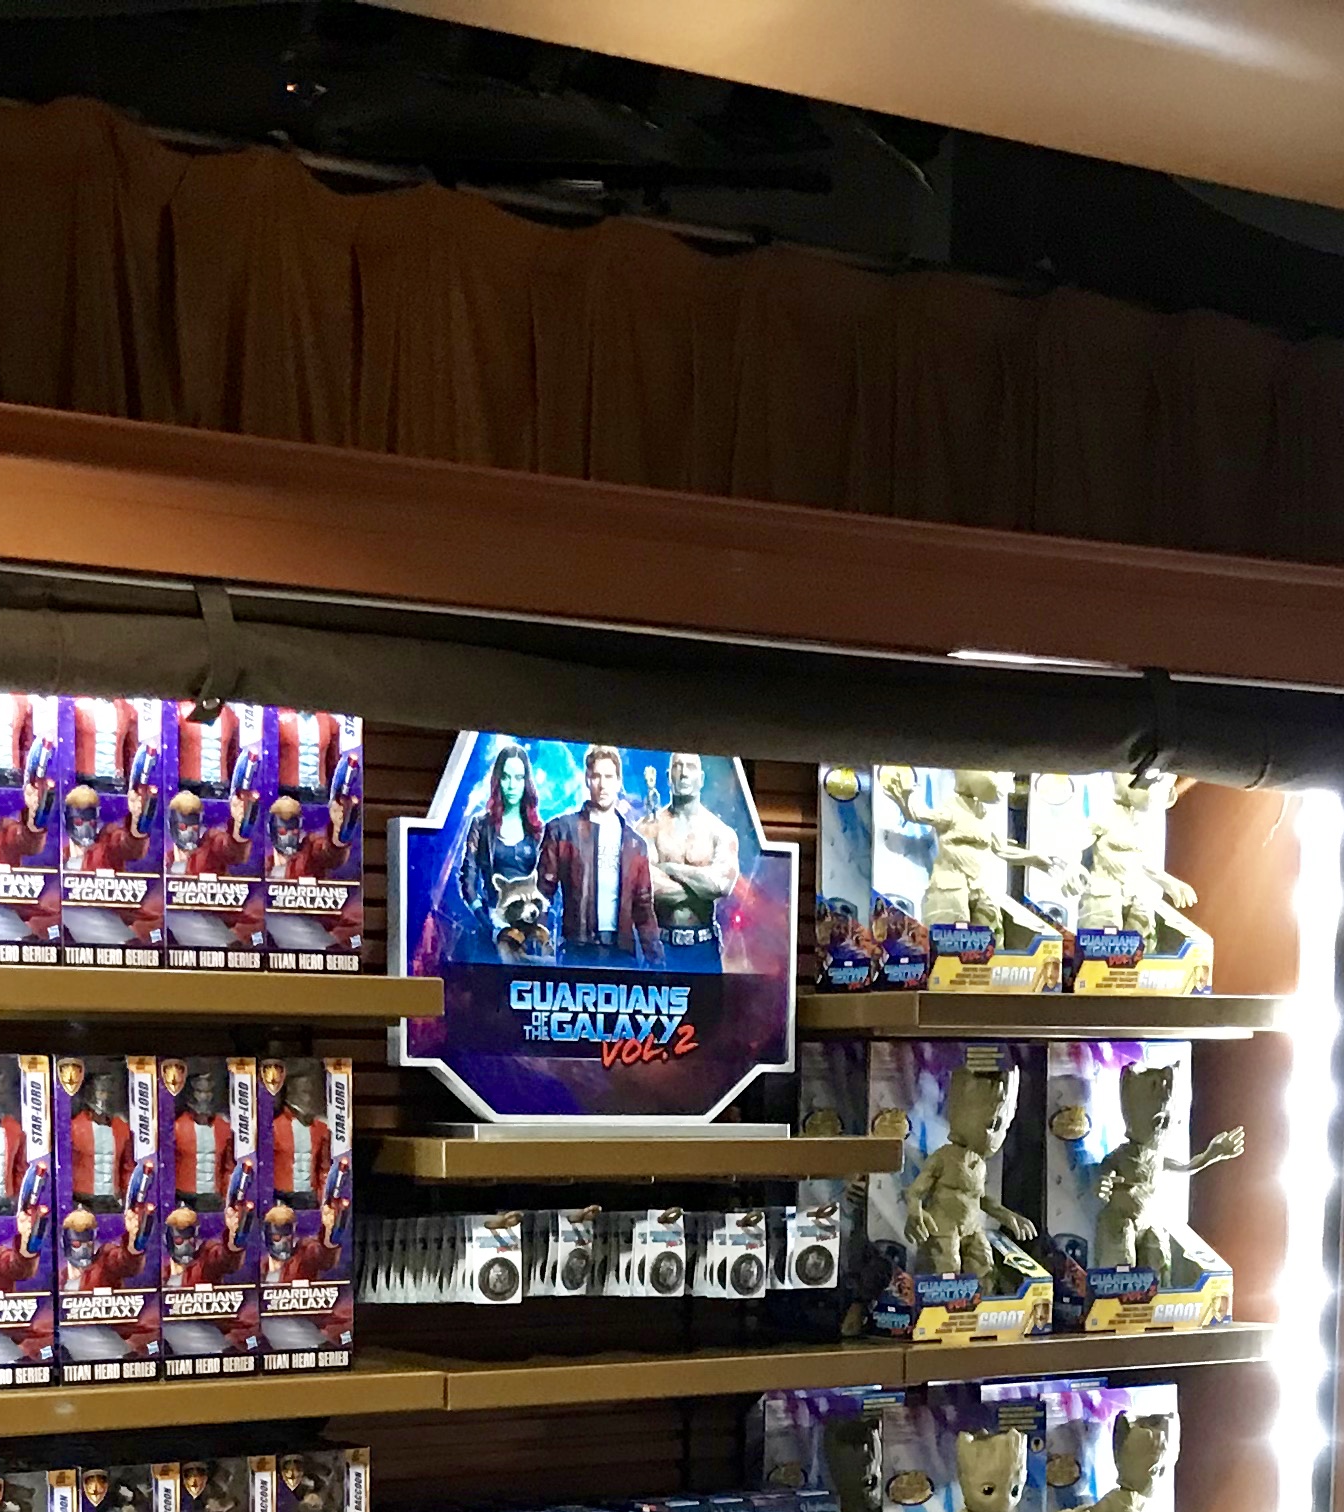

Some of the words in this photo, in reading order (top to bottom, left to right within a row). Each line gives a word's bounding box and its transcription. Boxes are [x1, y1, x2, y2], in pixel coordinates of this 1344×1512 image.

[64, 877, 147, 891] GUARDIANS
[168, 880, 249, 895] GUARDIANS
[268, 884, 348, 899] GUARDIANS
[80, 888, 145, 902] GALAXY
[185, 892, 247, 906] GALAXY
[284, 895, 347, 909] GALAXY
[22, 945, 57, 963] SERIES
[66, 947, 93, 964] TITAN
[97, 948, 122, 965] HERO
[125, 949, 159, 967] SERIES
[169, 950, 196, 967] TITAN
[200, 951, 225, 967] HERO
[228, 952, 260, 969] SERIES
[269, 953, 296, 970] TITAN
[299, 953, 323, 970] HERO
[327, 955, 359, 971] SERIES
[510, 980, 691, 1015] GUARDIANS
[531, 1011, 550, 1026] OF
[523, 1025, 551, 1041] THE
[550, 1012, 683, 1044] GALAXY
[602, 1032, 669, 1068] VOL.
[674, 1024, 699, 1055] 2
[32, 1080, 43, 1146] STAR-LORD
[139, 1080, 150, 1145] STAR-LORD
[238, 1081, 249, 1144] STAR-LORD
[336, 1081, 346, 1142] STAR-LORD
[62, 1295, 144, 1310] GUARDIANS
[165, 1291, 244, 1305] GUARDIANS
[263, 1287, 338, 1301] GUARDIANS
[79, 1305, 142, 1319] GALAXY
[181, 1301, 241, 1315] GALAXY
[279, 1297, 336, 1310] GALAXY
[979, 1310, 1025, 1329] GROOT
[165, 1359, 193, 1376] TITAN
[195, 1357, 220, 1374] HERO
[223, 1356, 255, 1373] SERIES
[264, 1353, 290, 1370] TITAN
[292, 1352, 315, 1368] HERO
[318, 1351, 349, 1367] SERIES
[15, 1367, 50, 1384] SERIES
[63, 1365, 91, 1382] TITAN
[94, 1363, 120, 1380] HERO
[123, 1361, 156, 1379] SERIES
